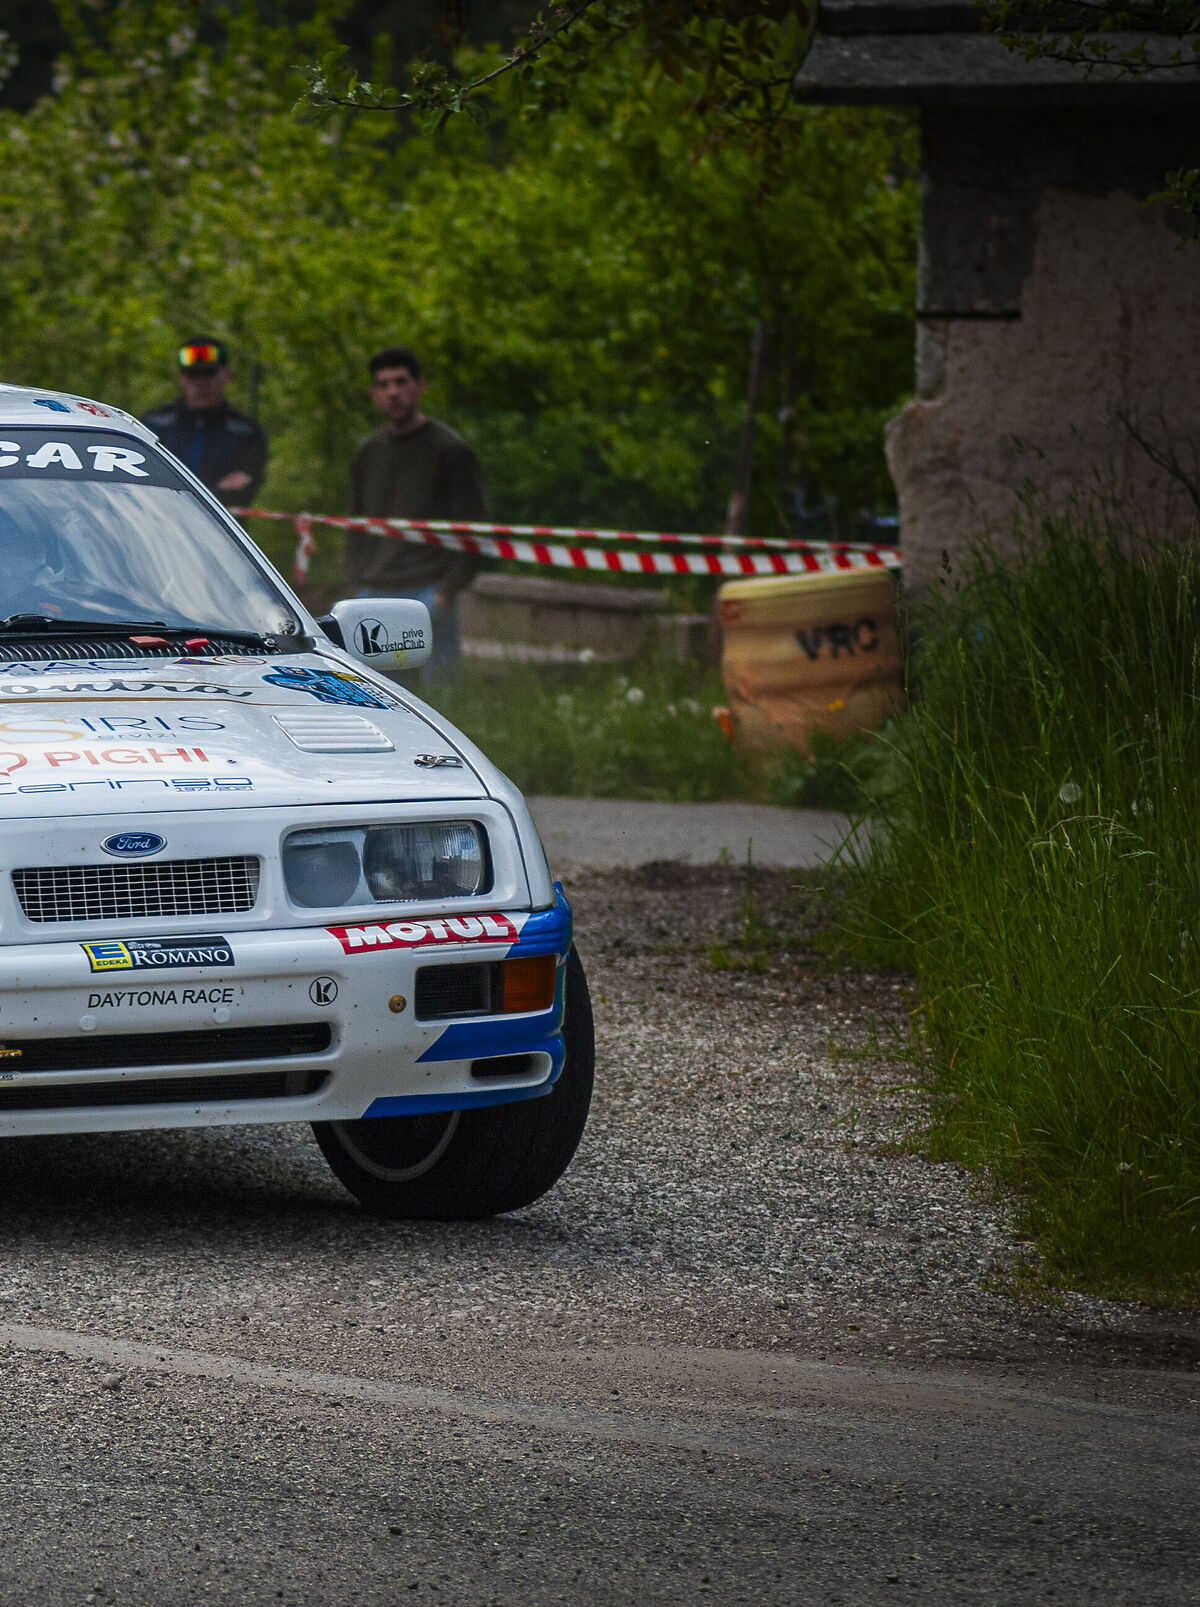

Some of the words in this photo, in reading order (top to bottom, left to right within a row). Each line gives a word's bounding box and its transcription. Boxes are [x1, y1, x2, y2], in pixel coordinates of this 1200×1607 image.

[402, 629, 425, 644] prive
[795, 617, 879, 660] VRC
[44, 748, 209, 768] PIGHI
[116, 836, 151, 850] Ford
[345, 916, 509, 948] MOTUL
[96, 959, 129, 967] EDEKA
[132, 949, 230, 966] ROMANO
[87, 990, 180, 1009] DAYTONA
[182, 988, 235, 1004] RACE
